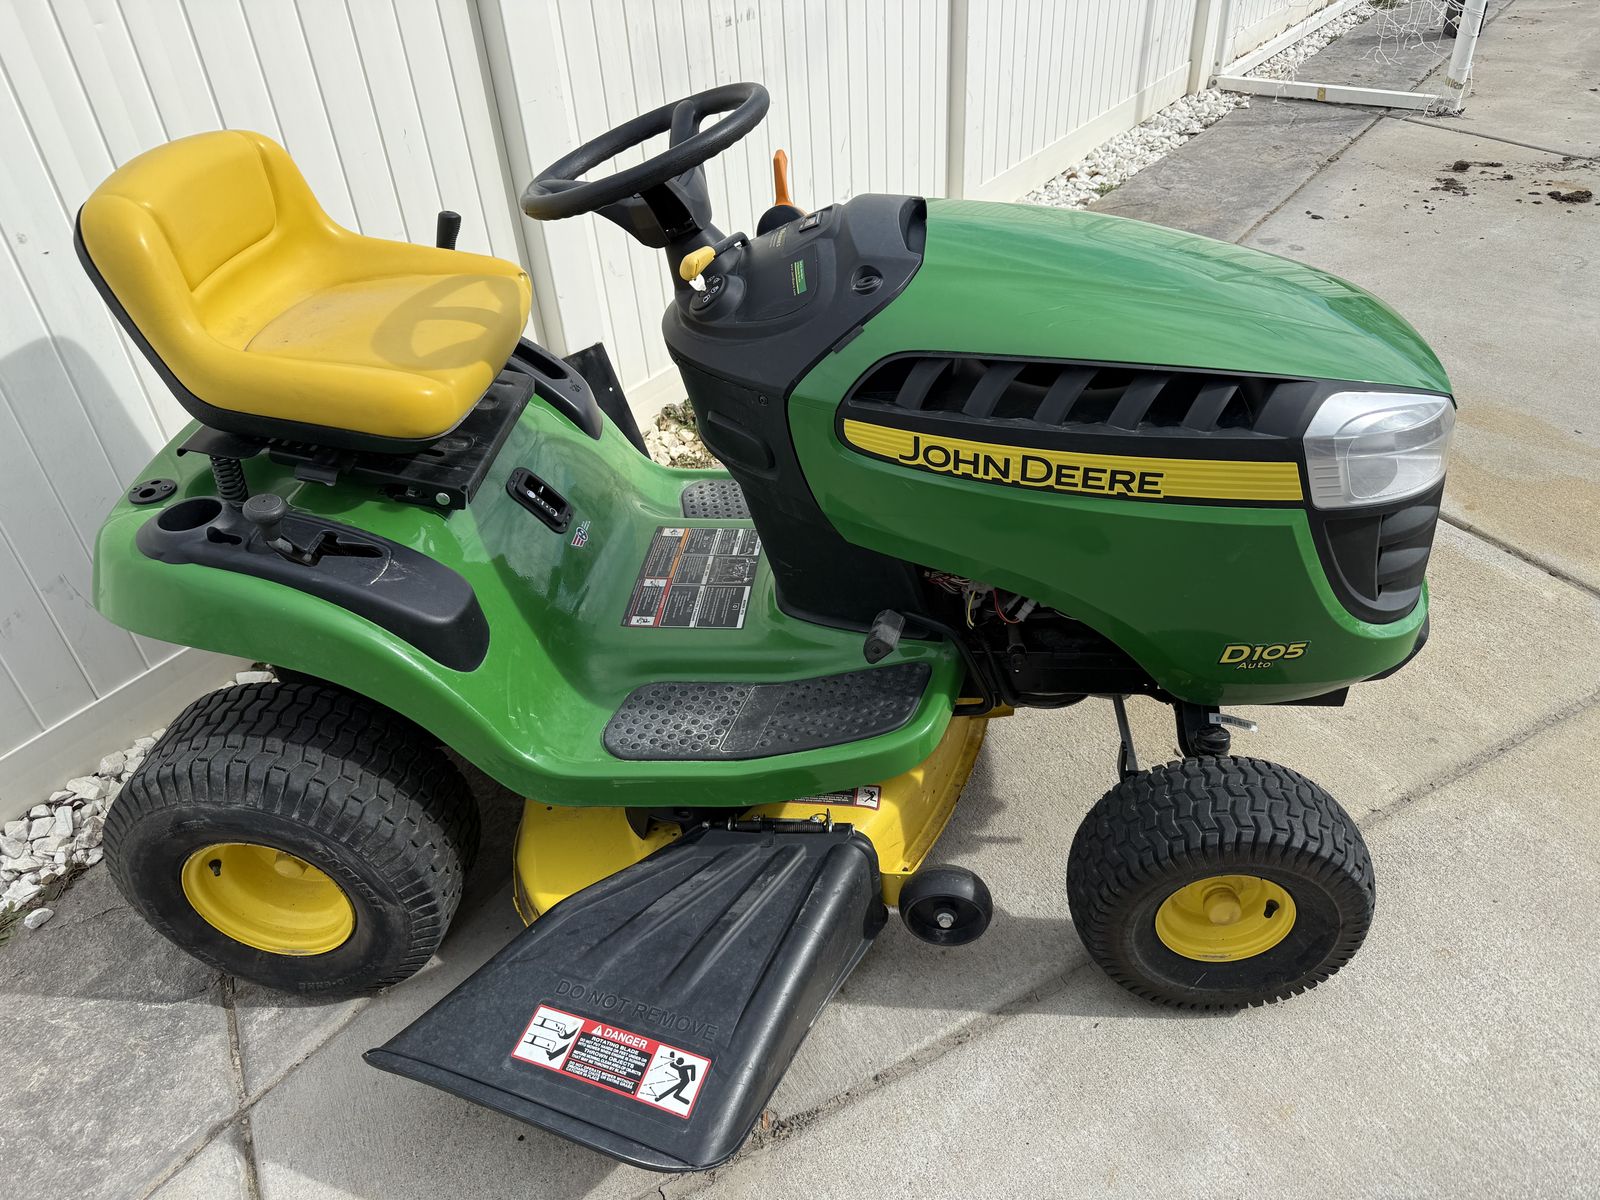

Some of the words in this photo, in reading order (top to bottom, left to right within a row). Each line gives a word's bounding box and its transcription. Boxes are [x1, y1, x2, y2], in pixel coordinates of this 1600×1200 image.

[899, 436, 1011, 479] JOHN
[1020, 454, 1164, 495] DEERE
[1219, 642, 1309, 664] D105
[1236, 661, 1272, 670] Auto
[555, 979, 585, 999] DO
[587, 990, 631, 1015] NOT
[632, 1003, 719, 1042] REMOVE
[591, 1036, 619, 1048] ROTATING
[619, 1045, 639, 1055] BLADE
[603, 1028, 648, 1048] DANGER
[583, 1047, 608, 1059] THROWN
[607, 1056, 634, 1068] OBJECTS
